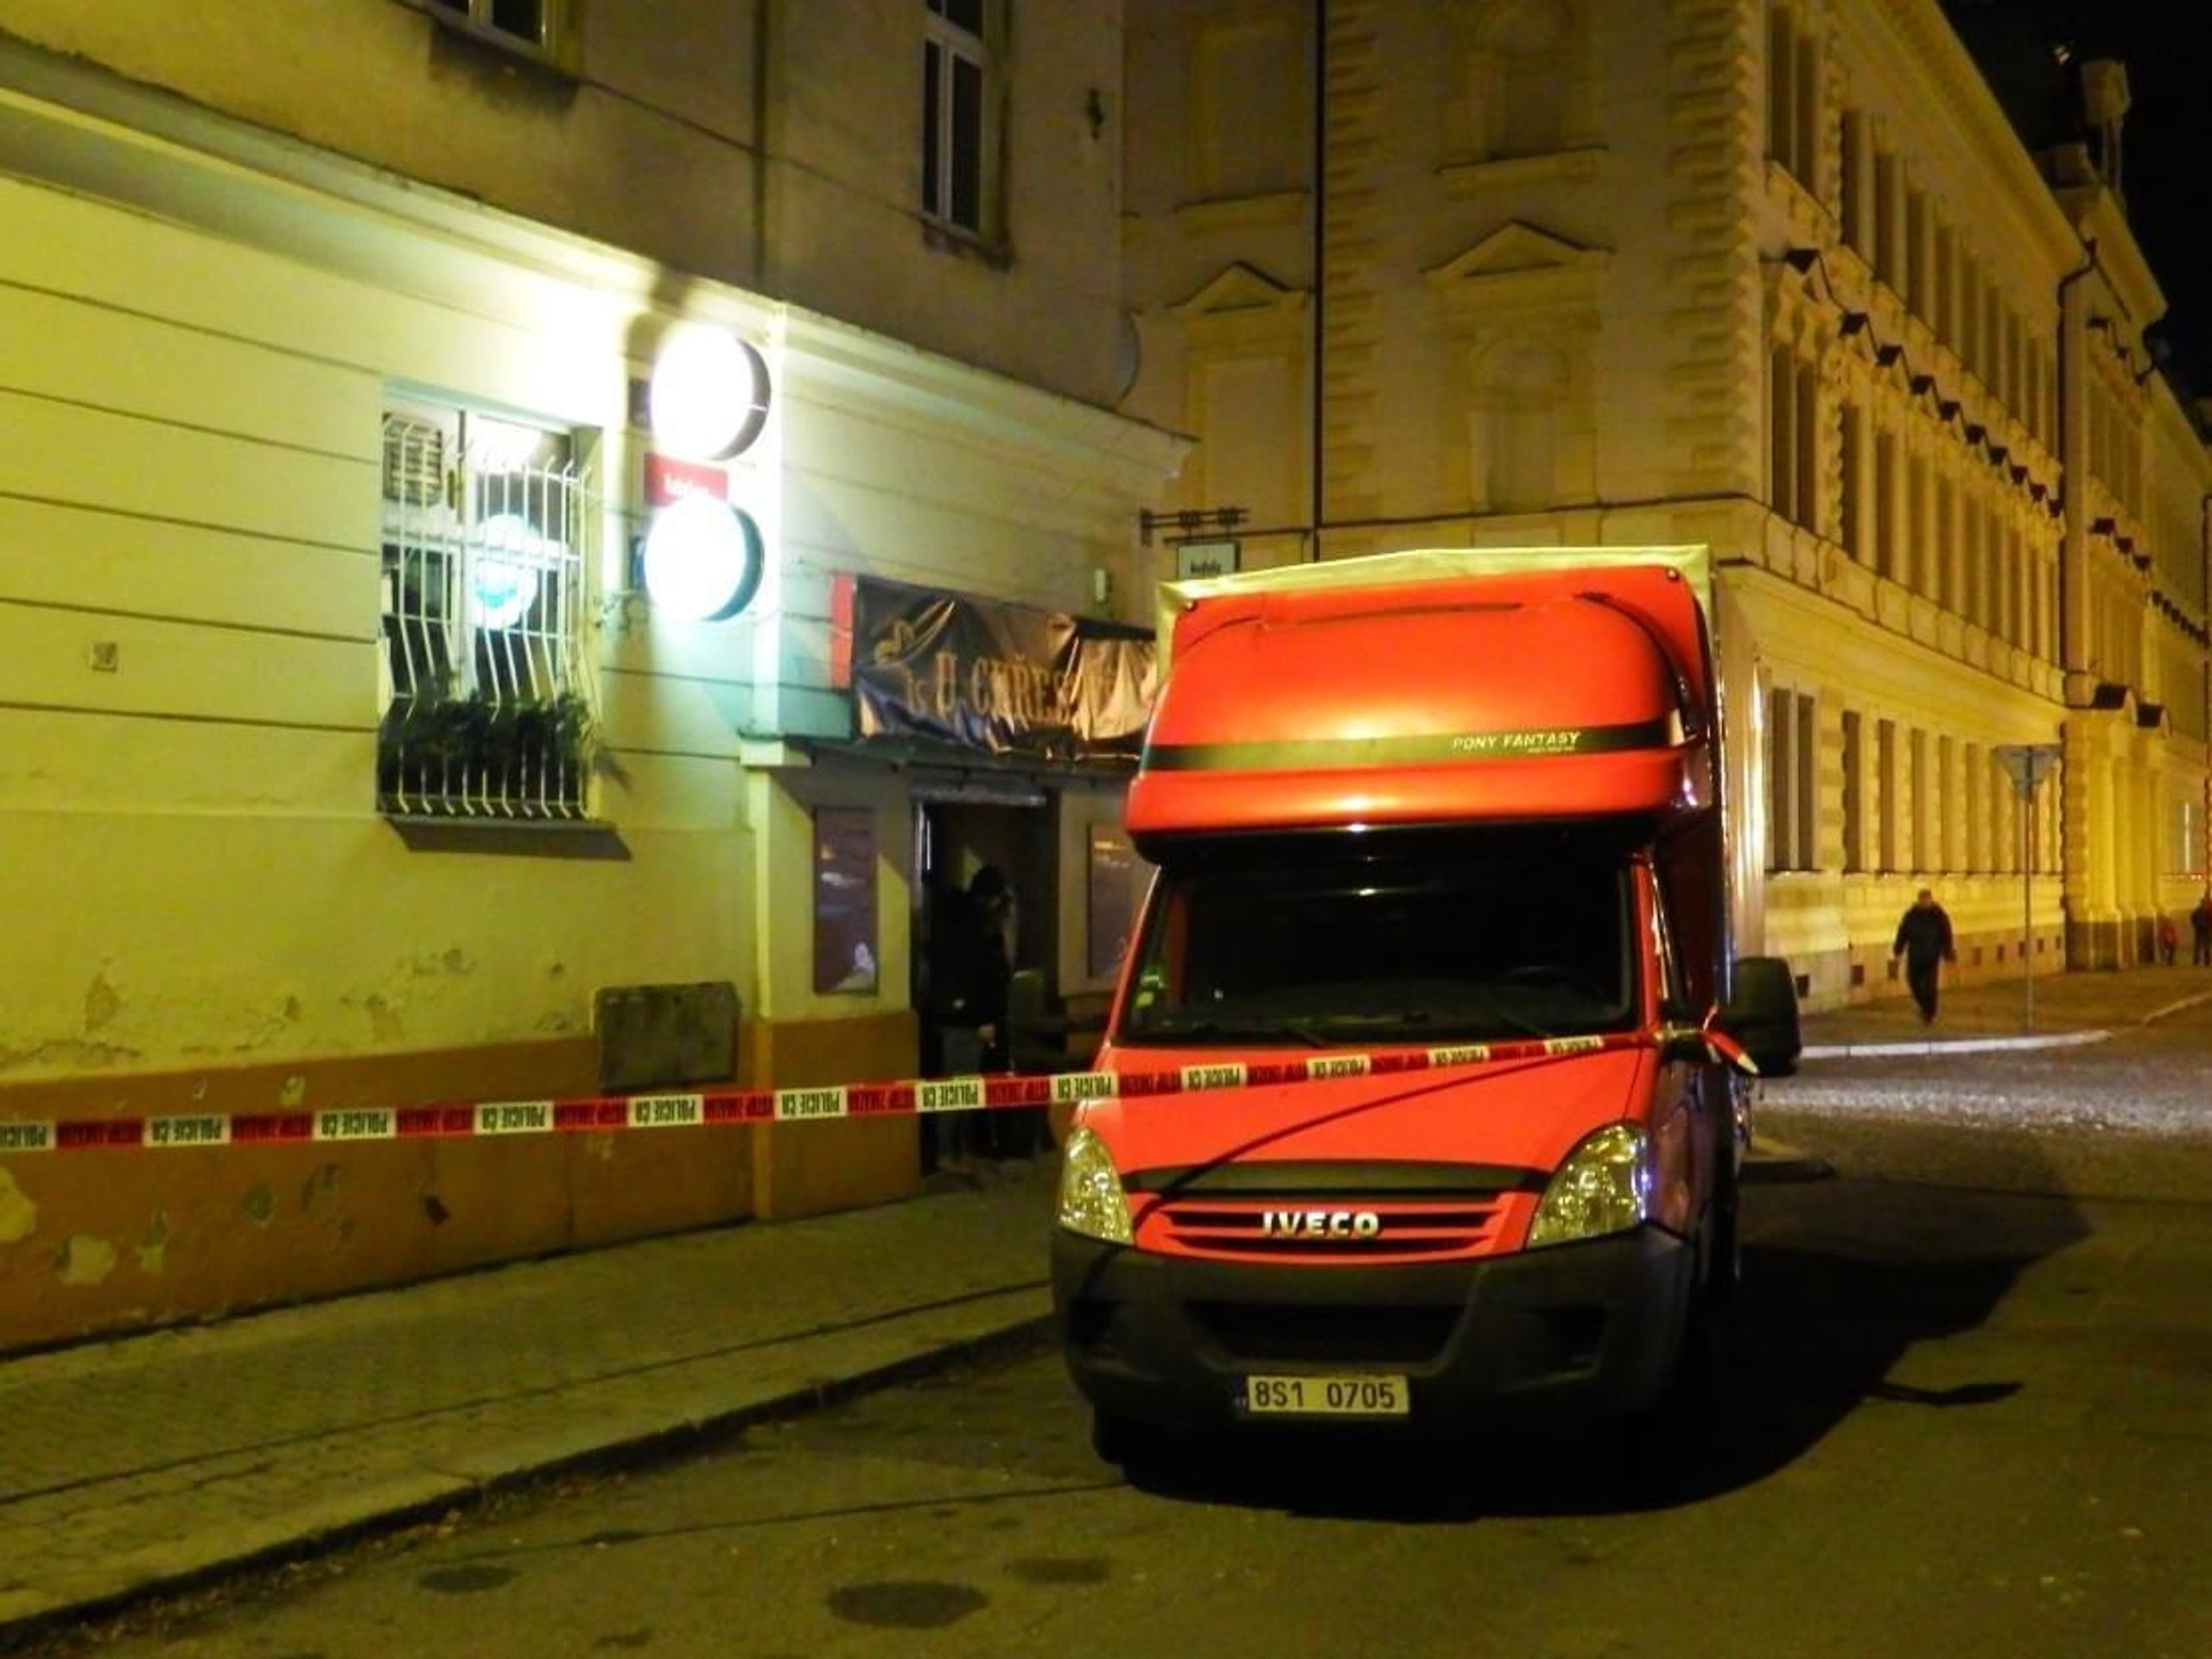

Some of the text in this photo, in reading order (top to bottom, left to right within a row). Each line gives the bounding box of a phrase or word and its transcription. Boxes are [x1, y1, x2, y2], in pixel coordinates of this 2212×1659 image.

[1503, 731, 1580, 748] FANTASY
[939, 1084, 978, 1106] POLICIE
[1076, 1077, 1111, 1097] POLICIE
[654, 1099, 696, 1122] POLICIE
[799, 1092, 841, 1114] POLICIE
[342, 1111, 388, 1135] POLICIE
[502, 1105, 546, 1128] POLICIE
[1263, 1211, 1380, 1236] IVECO
[1255, 1381, 1395, 1409] 8S1 0705
